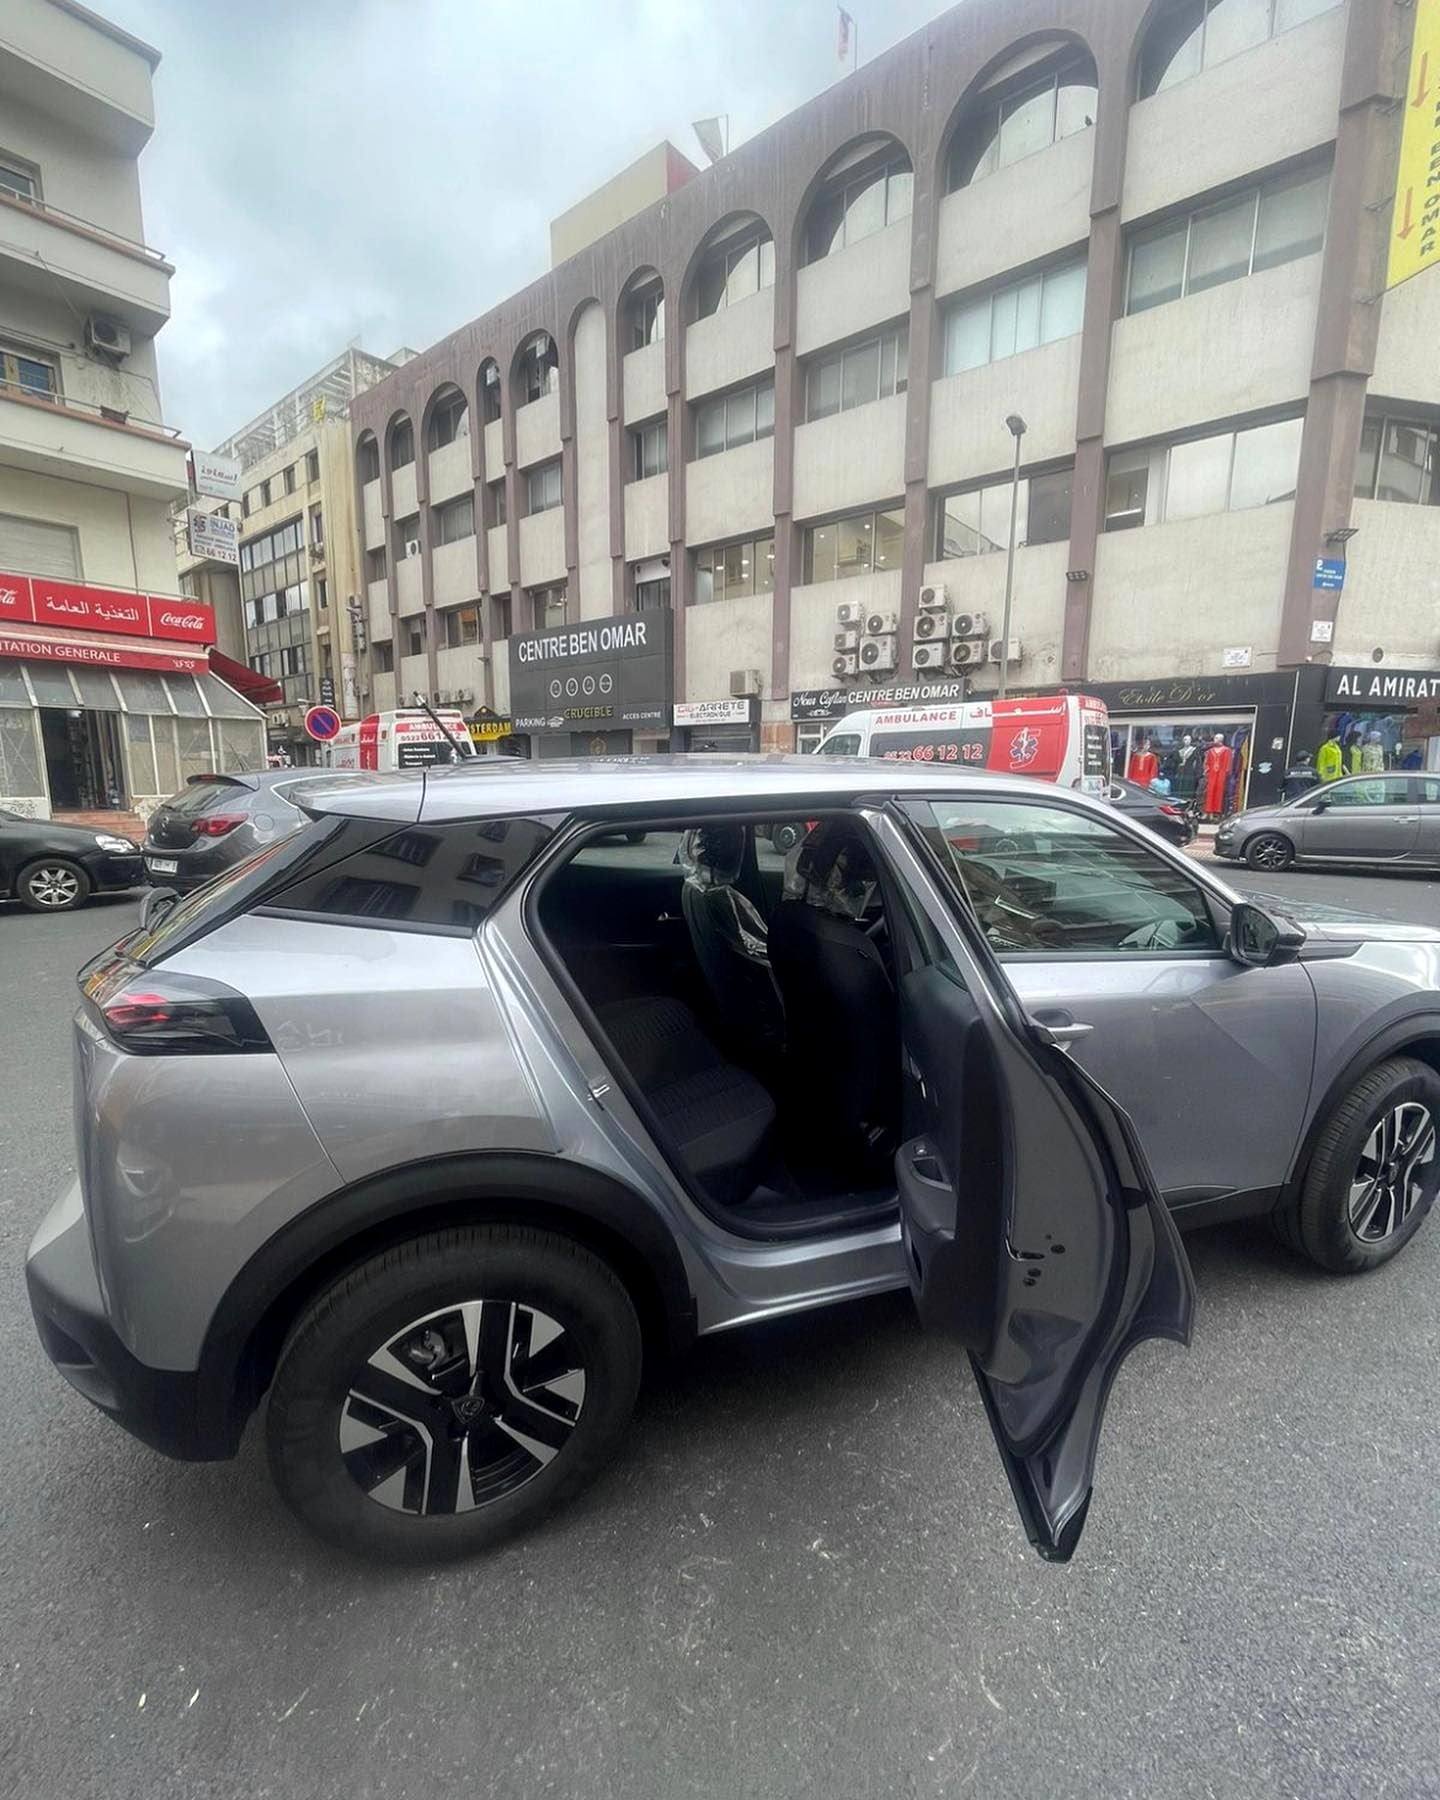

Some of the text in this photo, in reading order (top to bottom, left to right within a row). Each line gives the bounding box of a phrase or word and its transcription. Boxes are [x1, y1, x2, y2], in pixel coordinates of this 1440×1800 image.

[46, 596, 90, 614] العامة
[518, 622, 647, 663] CENTRE BEN OMAR
[54, 645, 121, 662] GENERALE
[1336, 674, 1362, 696] AL
[848, 684, 959, 704] CENTRE BEN OMAR
[564, 705, 613, 719] CRUCIBLE
[875, 711, 957, 725] AMBULANCE
[468, 722, 511, 734] STERDAM
[515, 716, 546, 728] PARKING
[912, 745, 934, 761] 66
[937, 744, 958, 760] 12
[962, 744, 984, 760] 12
